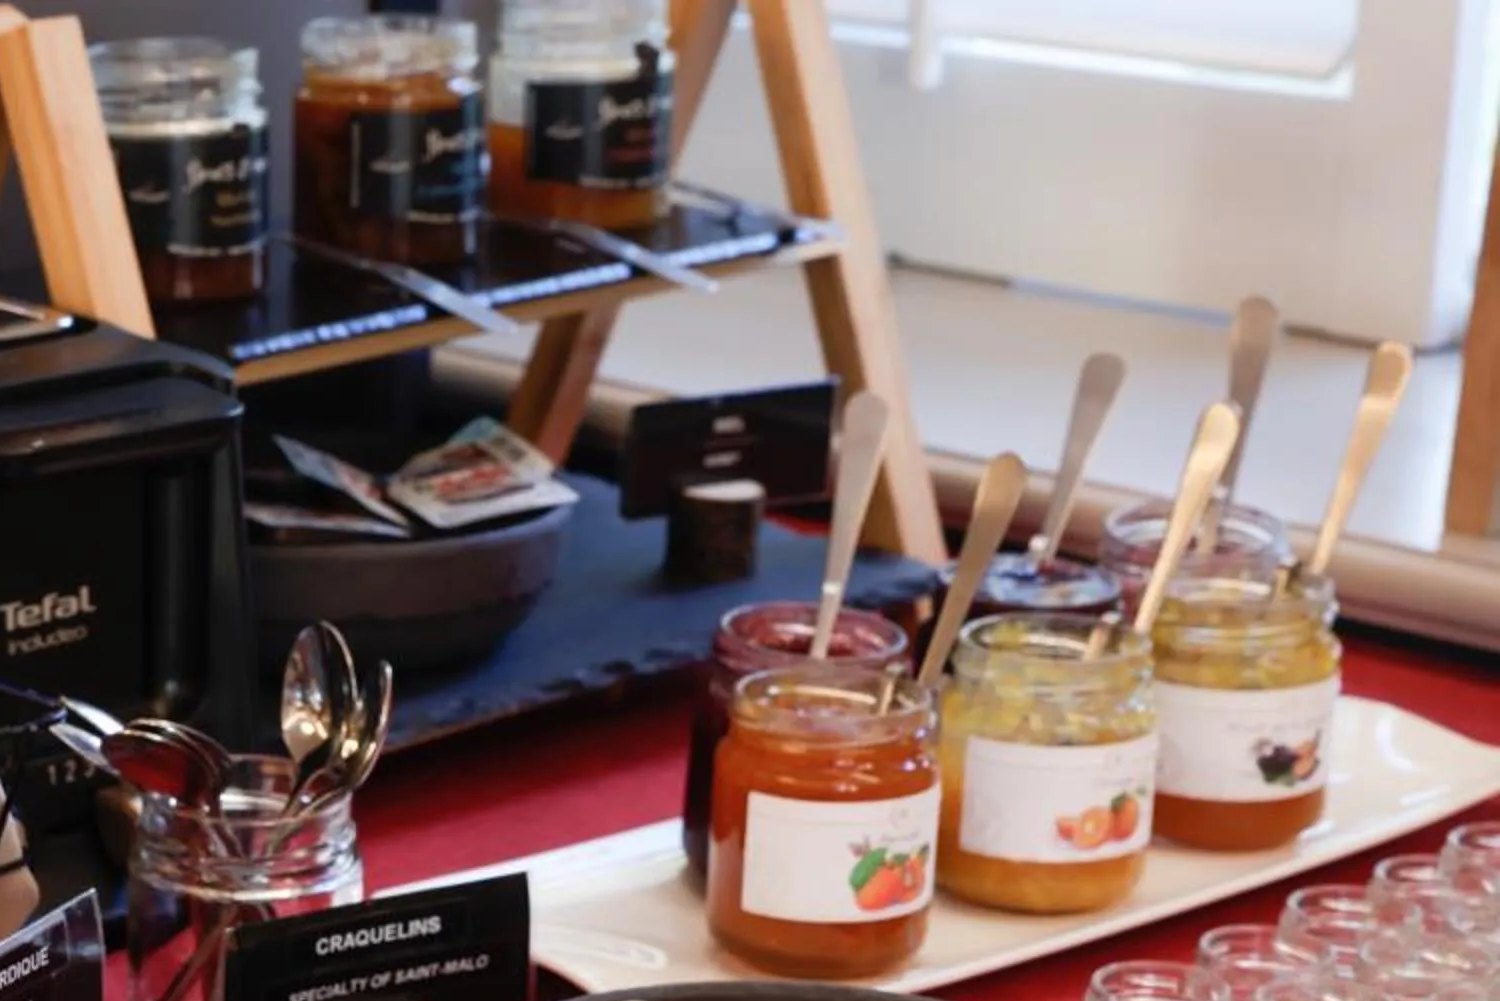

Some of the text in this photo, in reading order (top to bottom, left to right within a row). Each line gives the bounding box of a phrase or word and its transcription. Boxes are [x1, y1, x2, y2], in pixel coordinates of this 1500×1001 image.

[47, 763, 57, 787] 1
[64, 758, 77, 783] 2
[315, 915, 442, 956] CRAQUELINS
[370, 971, 392, 989] OF
[395, 953, 490, 985] SAINT-MALO
